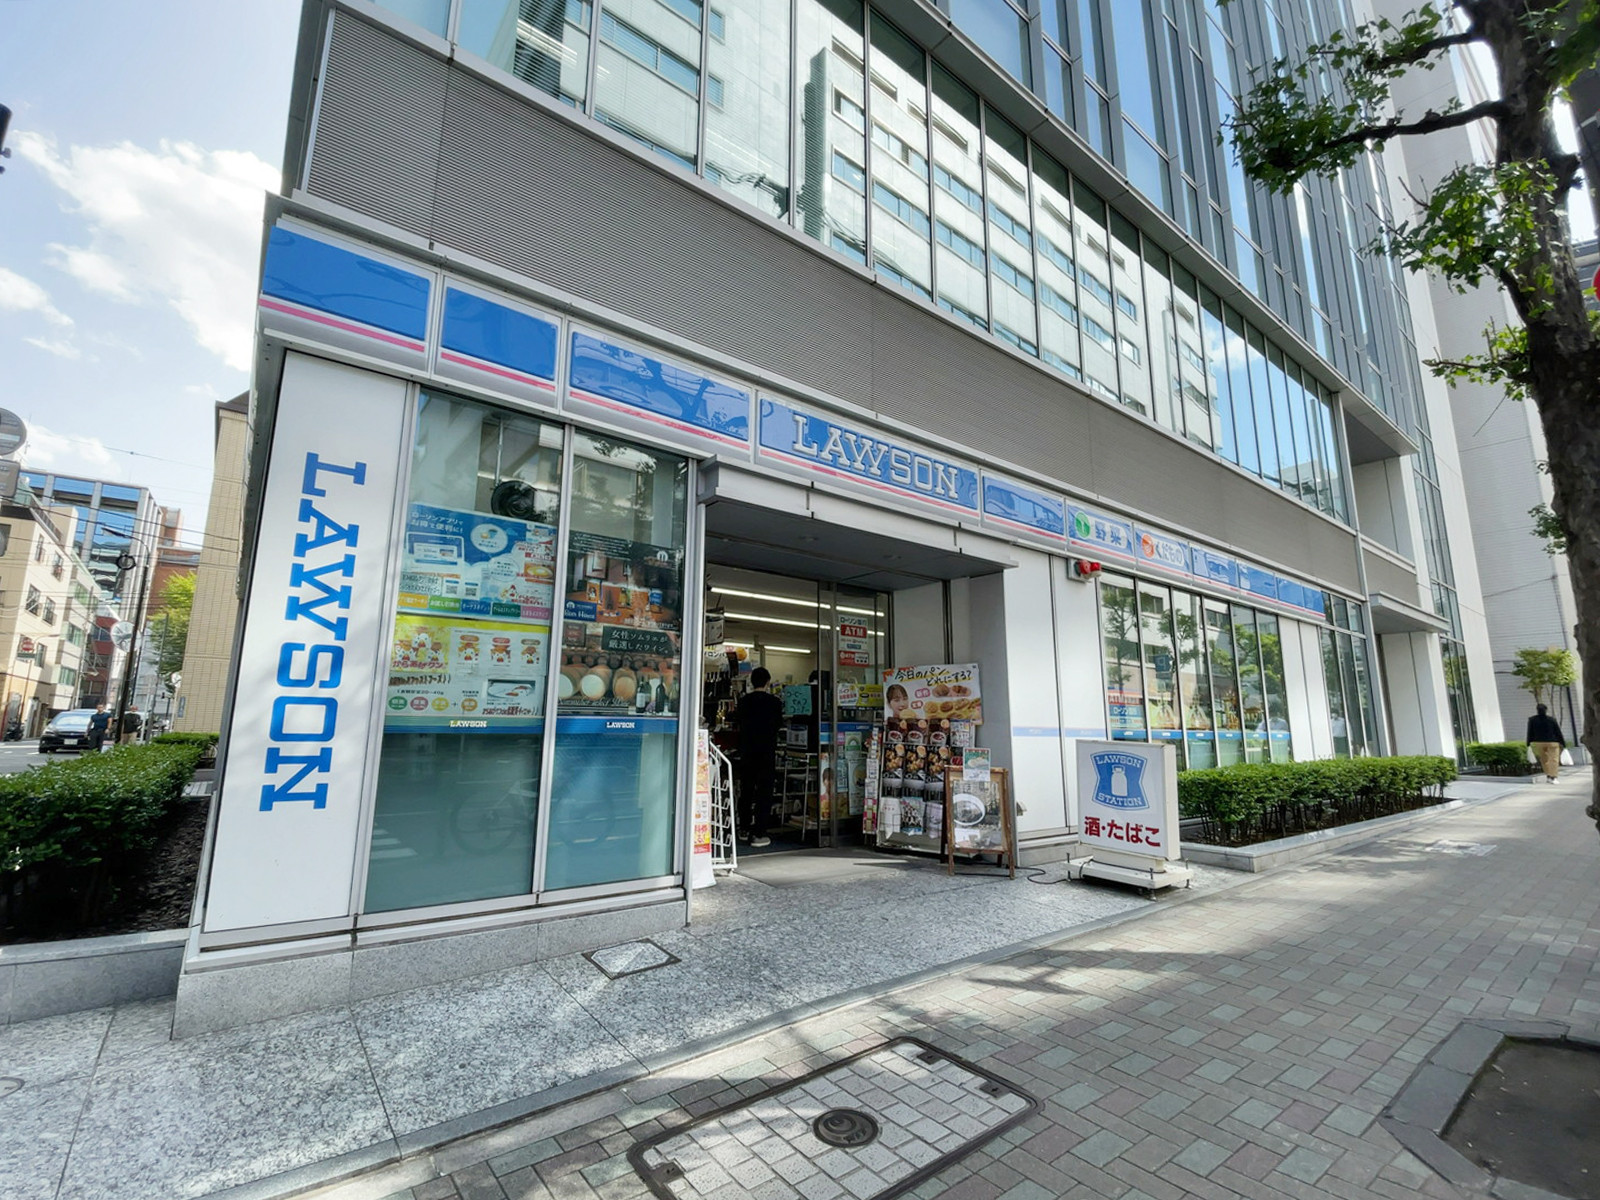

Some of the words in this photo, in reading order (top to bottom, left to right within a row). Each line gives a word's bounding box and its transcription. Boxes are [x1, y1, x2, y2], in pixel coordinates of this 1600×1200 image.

[792, 413, 959, 499] LAWSON
[1094, 519, 1122, 546] 野菜
[259, 451, 368, 812] LAWSON
[611, 629, 669, 643] 女性ソムリエが
[844, 626, 864, 637] ATM
[895, 666, 948, 682] 今日のパン
[926, 669, 972, 687] どれにする?
[449, 720, 488, 728] LAWSON
[606, 721, 635, 729] LAWSON
[1095, 755, 1142, 768] LAWSON
[1097, 792, 1142, 807] STATION
[1084, 815, 1161, 848] 酒・たばこ
